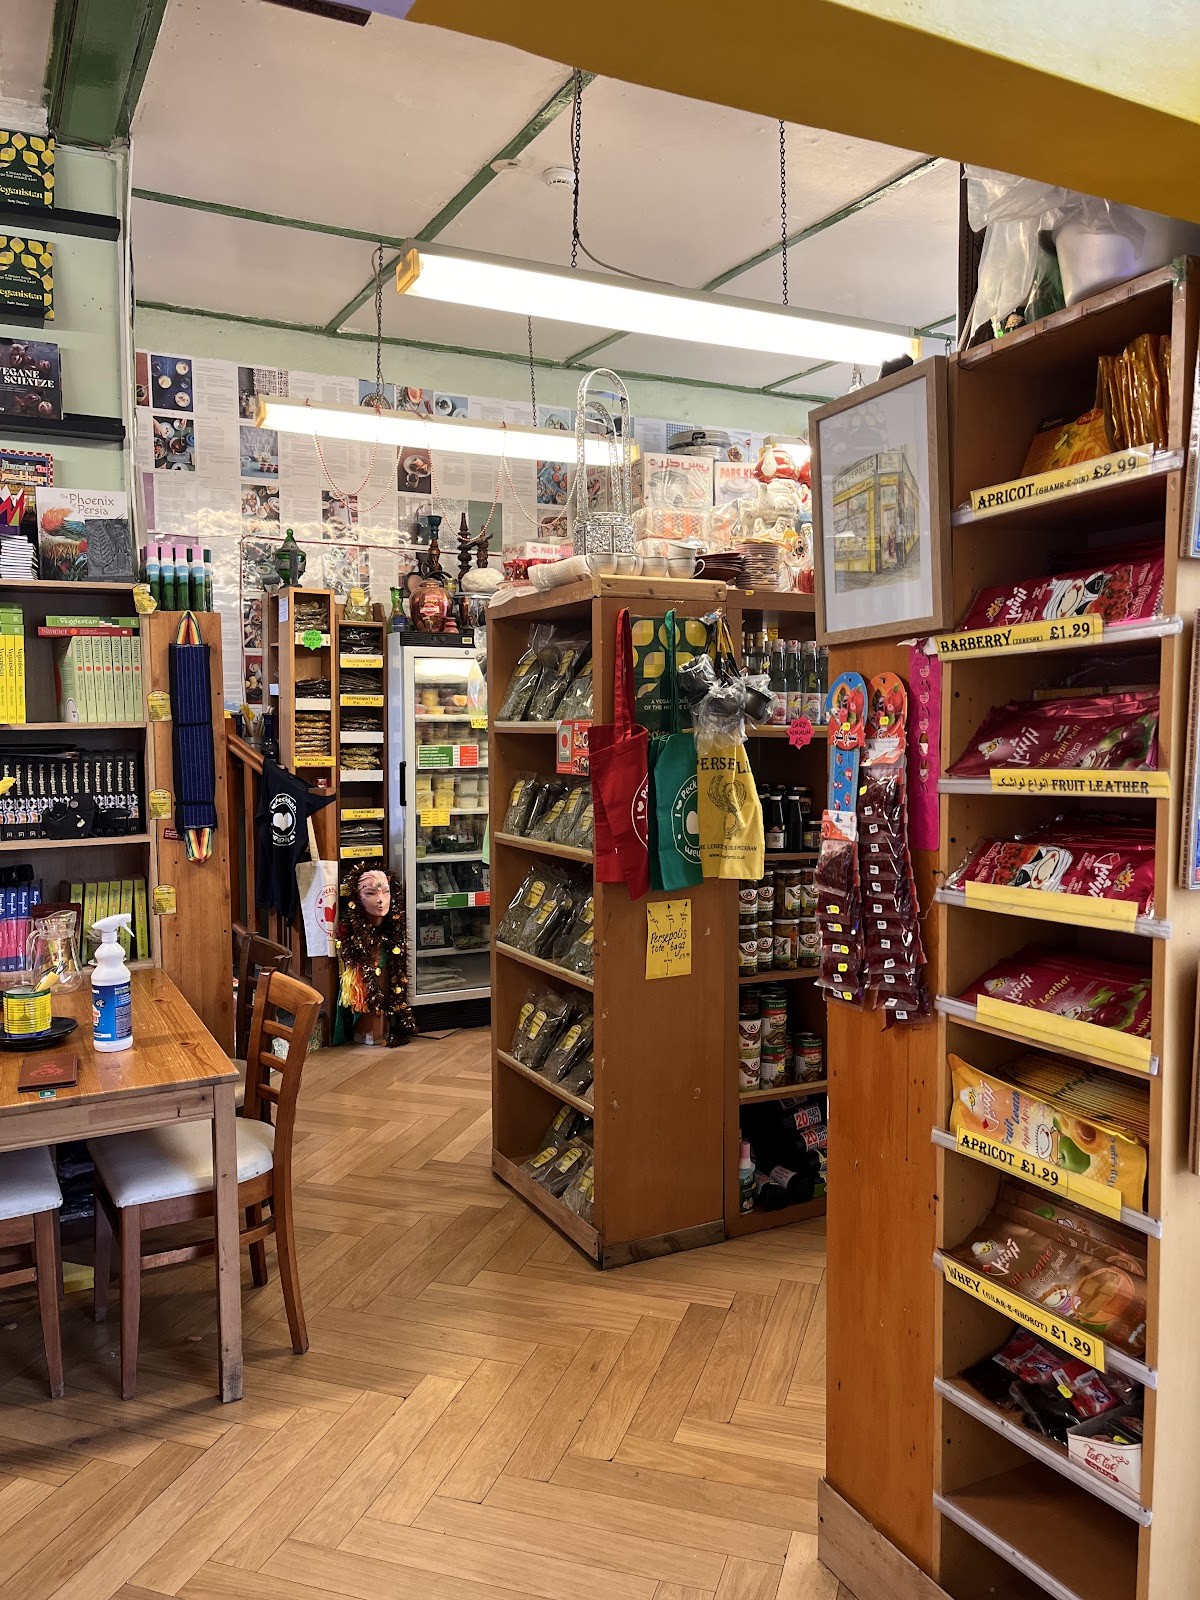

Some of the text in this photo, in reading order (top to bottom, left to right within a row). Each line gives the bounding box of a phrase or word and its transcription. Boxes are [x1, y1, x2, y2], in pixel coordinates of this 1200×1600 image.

[0, 185, 43, 199] eganistan
[0, 288, 42, 301] eganistan
[720, 467, 742, 479] PARS
[977, 483, 1035, 510] APRICOT
[1092, 456, 1137, 480] £2.99
[69, 493, 115, 507] Phoenix
[78, 504, 109, 516] Persia
[940, 629, 1012, 653] BARBERRY
[1050, 622, 1090, 640] £1.29
[1052, 739, 1070, 760] Fruit
[681, 780, 697, 799] Peck
[1051, 779, 1150, 795] FRUIT LEATHER
[650, 927, 688, 945] Persepolis
[651, 941, 686, 957] tote bags
[1038, 974, 1071, 1004] Leather
[1012, 1090, 1021, 1124] Leath
[1021, 1128, 1030, 1149] Apple
[960, 1134, 1059, 1187] APRICOT £1.29
[947, 1263, 982, 1294] WHEY
[1050, 1324, 1092, 1358] £1.29
